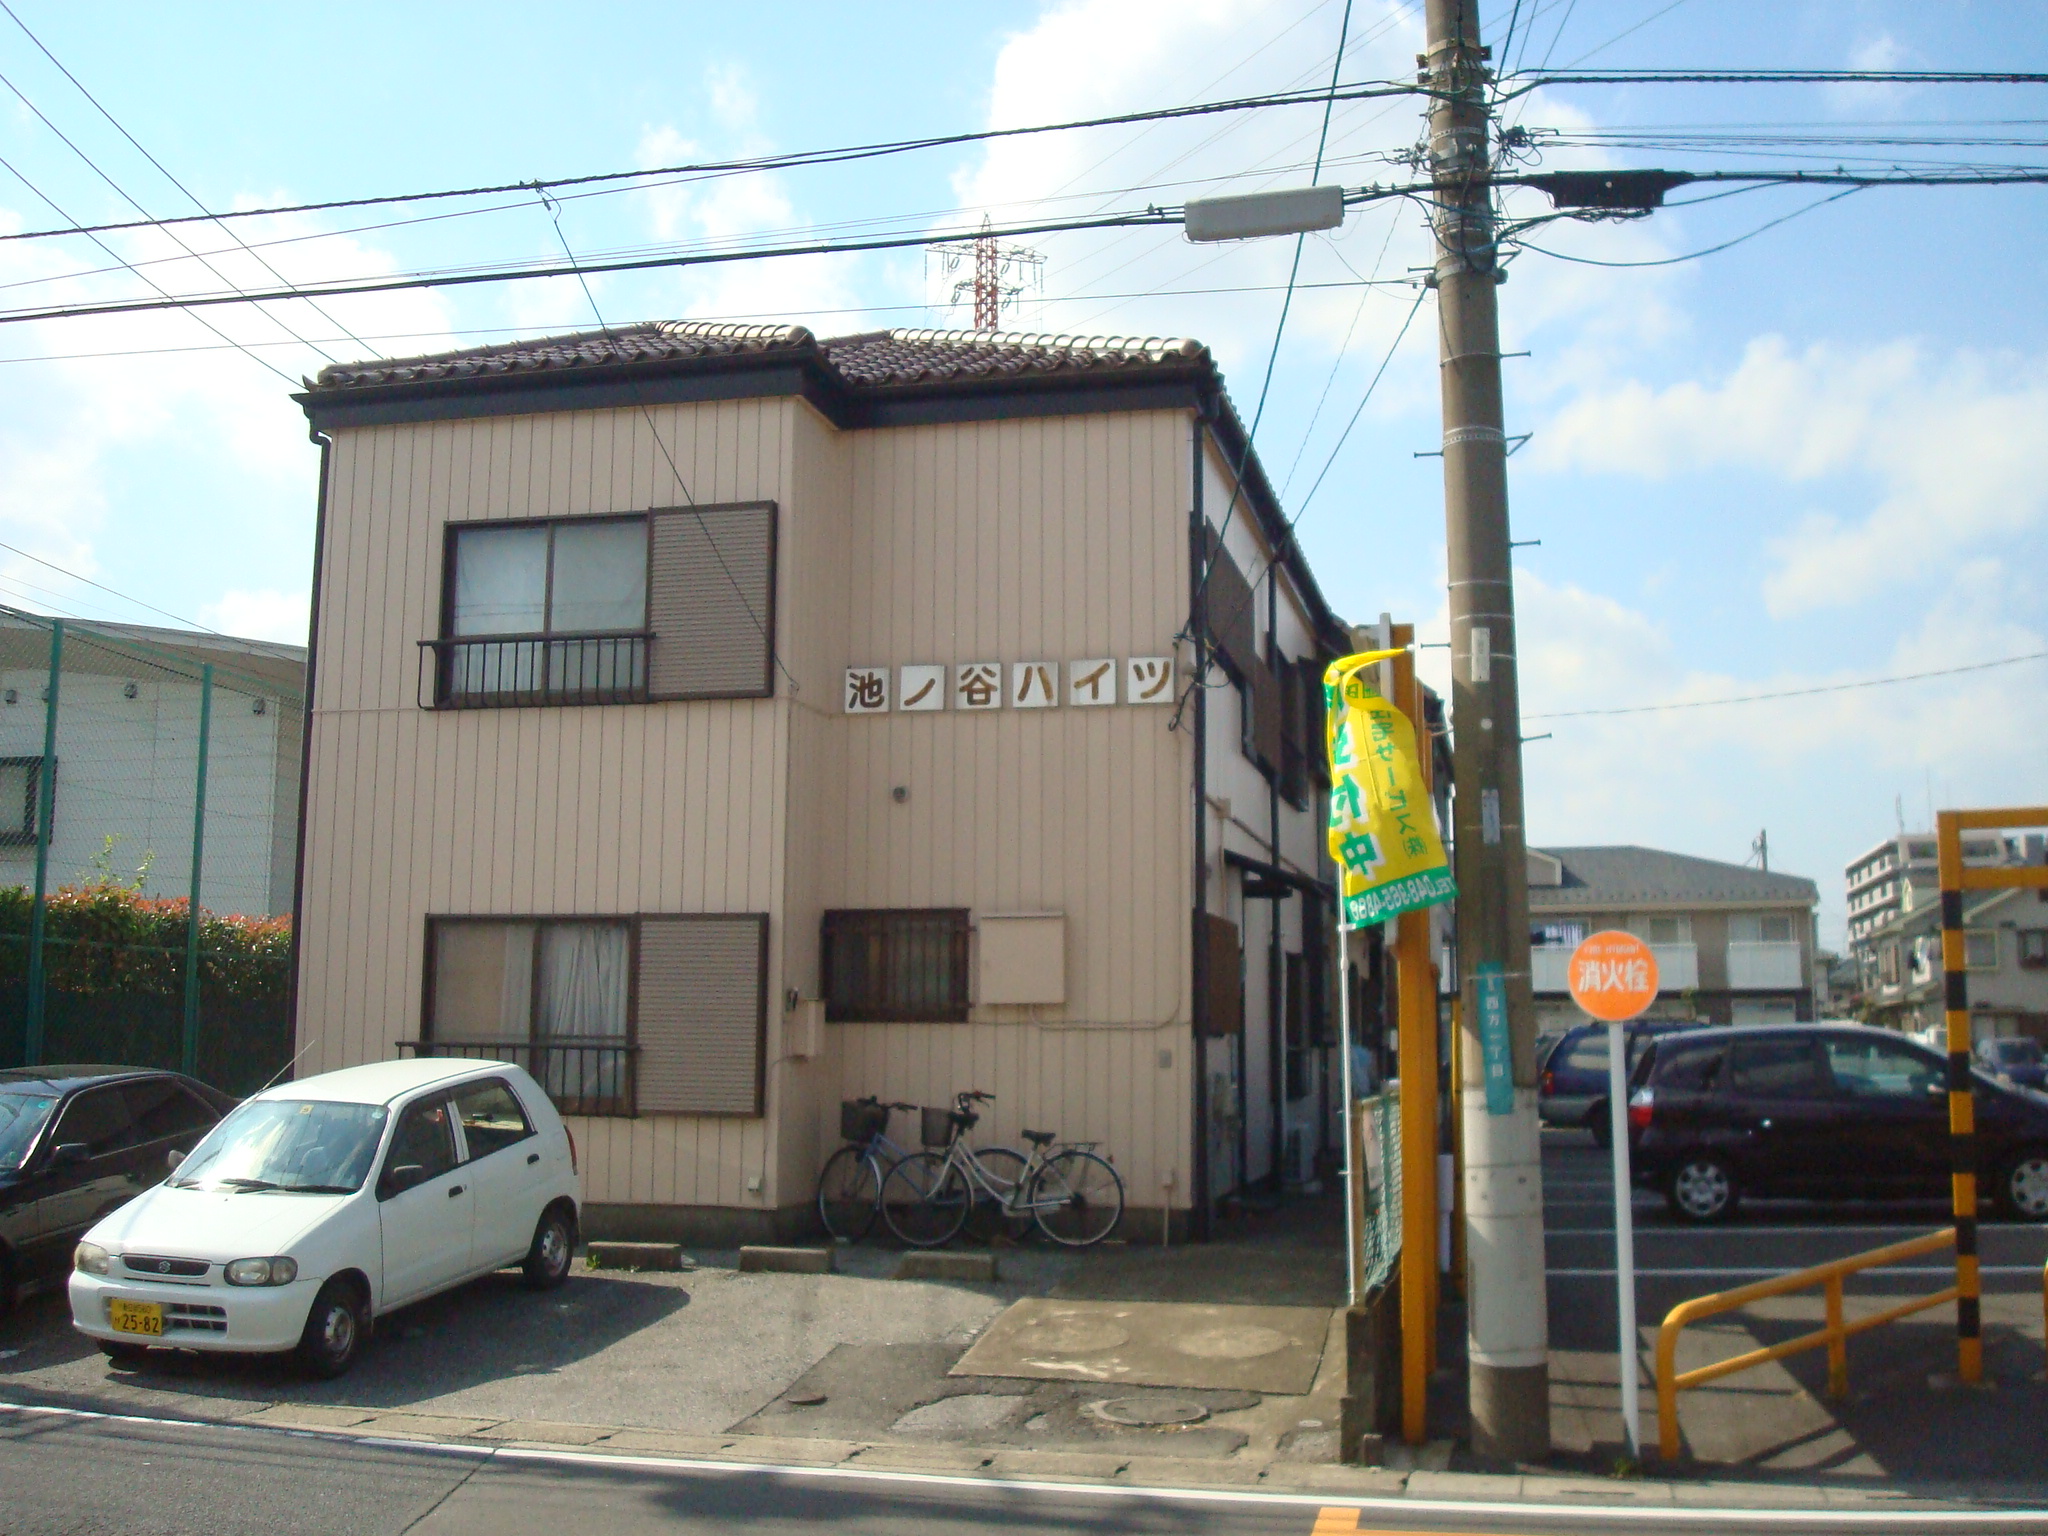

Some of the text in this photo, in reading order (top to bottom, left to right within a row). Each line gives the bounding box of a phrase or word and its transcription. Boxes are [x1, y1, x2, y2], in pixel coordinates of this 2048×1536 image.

[848, 660, 1170, 709] 池ノ谷ハイツ
[1578, 957, 1649, 993] 消火栓
[122, 1313, 159, 1333] 25-82
